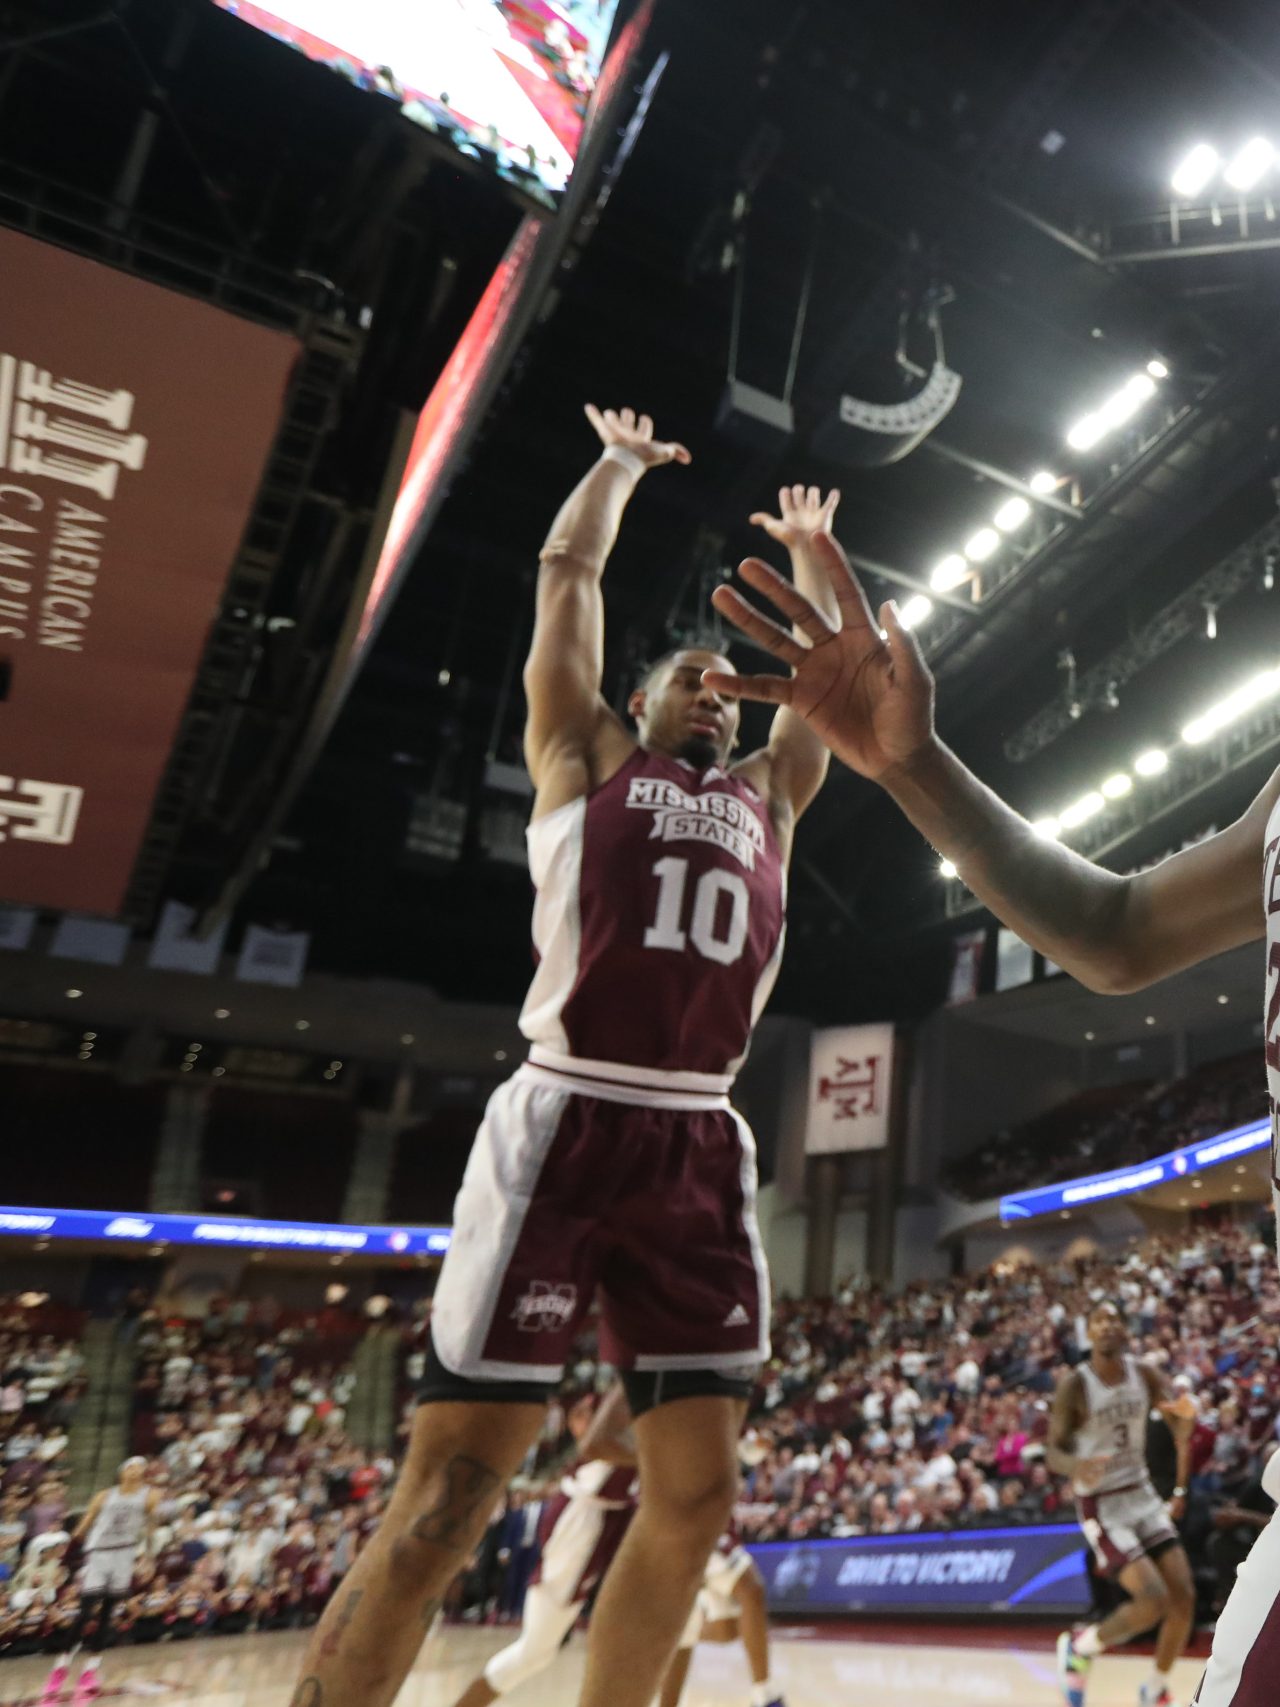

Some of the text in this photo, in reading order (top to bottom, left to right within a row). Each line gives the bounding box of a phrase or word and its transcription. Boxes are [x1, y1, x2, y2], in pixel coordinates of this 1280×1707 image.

[38, 498, 108, 651] AMERICAN
[673, 817, 742, 857] STATE
[643, 856, 750, 967] 10
